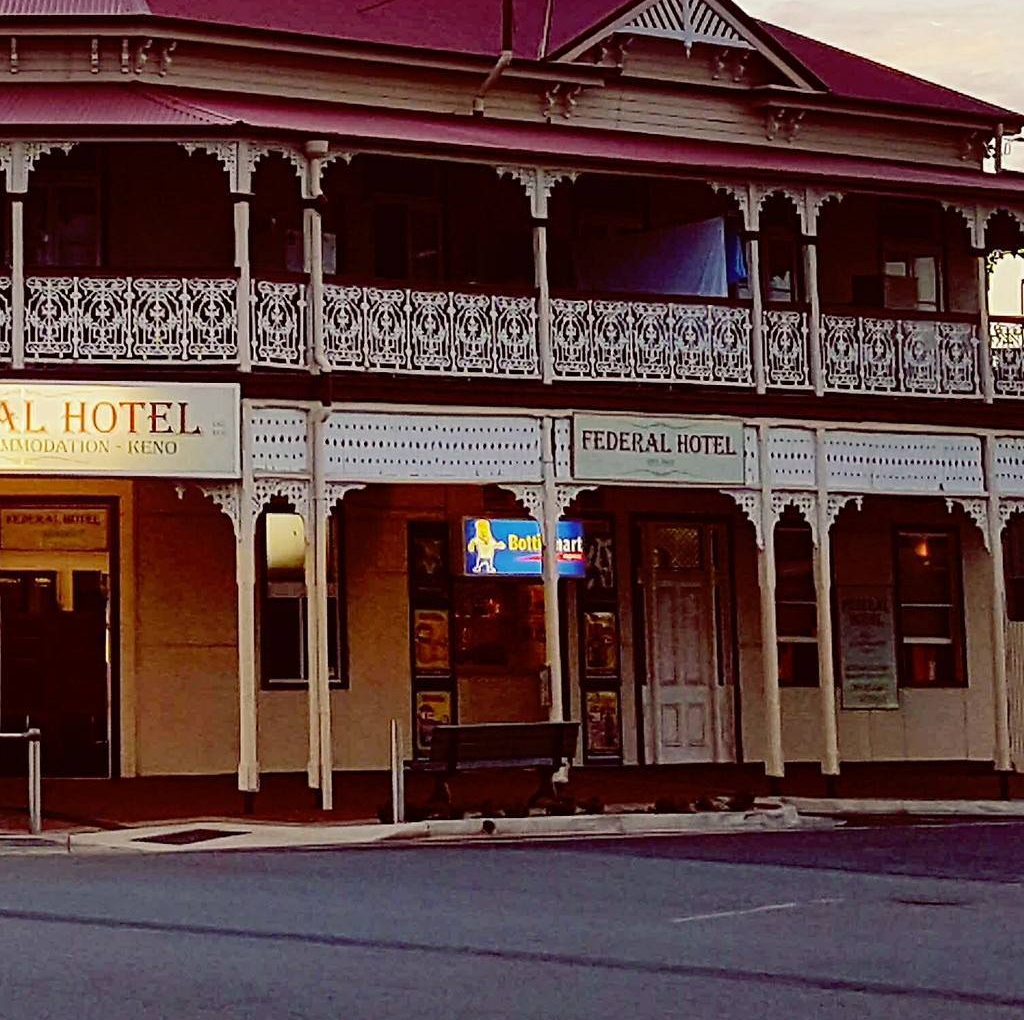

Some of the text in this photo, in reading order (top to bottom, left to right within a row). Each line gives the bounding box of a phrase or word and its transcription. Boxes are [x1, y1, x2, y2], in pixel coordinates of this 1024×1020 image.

[61, 400, 202, 435] HOTEL
[127, 439, 178, 455] KENO
[582, 430, 738, 456] FEDERAL HOTEL
